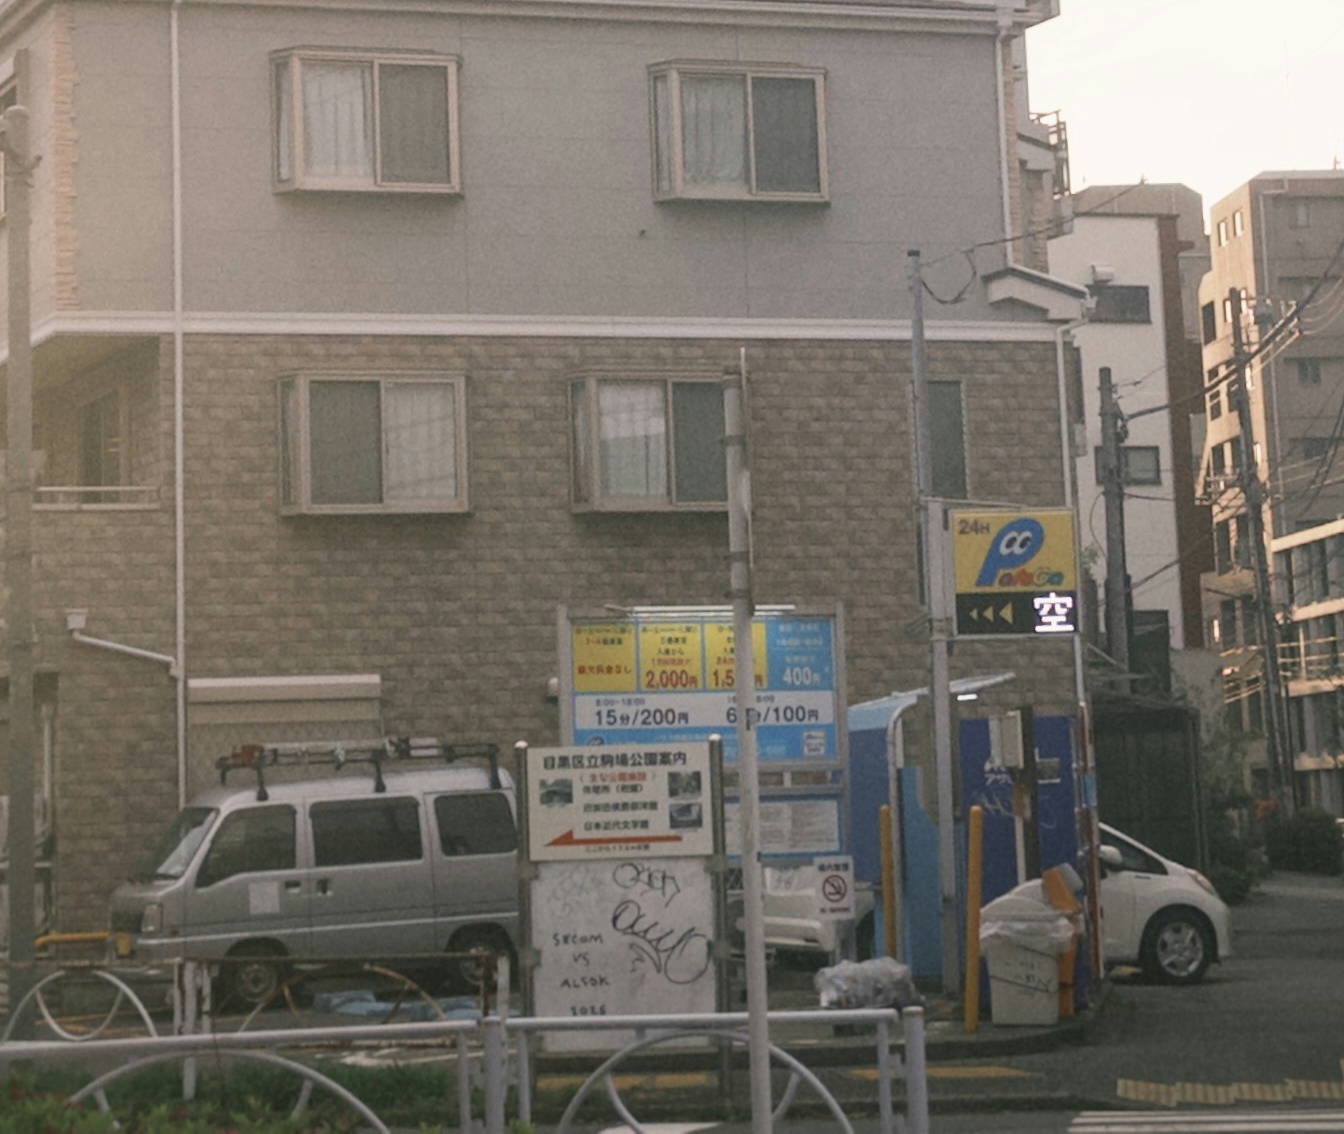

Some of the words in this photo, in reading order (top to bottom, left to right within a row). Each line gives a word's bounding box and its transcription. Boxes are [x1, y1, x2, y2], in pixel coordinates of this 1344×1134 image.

[958, 519, 989, 534] 24H
[1033, 592, 1074, 633] 空
[645, 670, 698, 688] 2,000円
[782, 667, 821, 686] 400円
[595, 709, 689, 726] 15分/200円
[543, 752, 687, 770] 目黒区立駒場公園案内
[583, 820, 649, 831] 日本近代文学館
